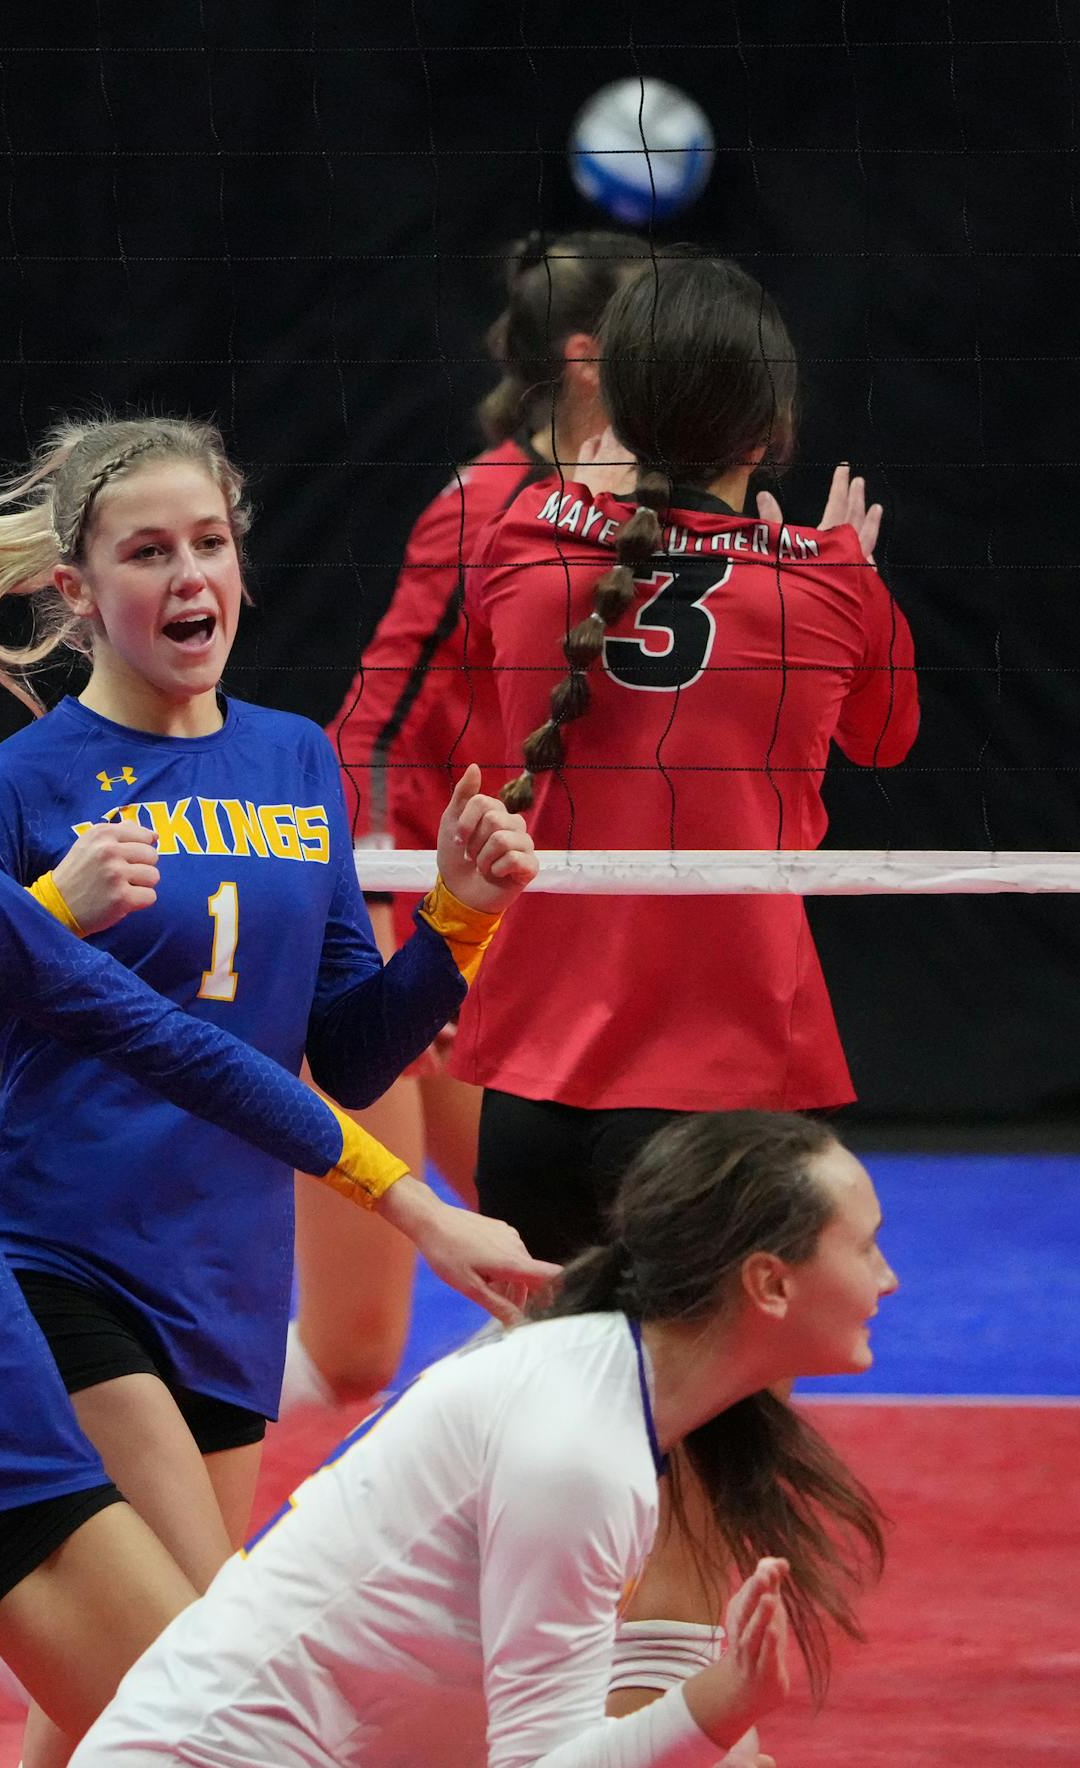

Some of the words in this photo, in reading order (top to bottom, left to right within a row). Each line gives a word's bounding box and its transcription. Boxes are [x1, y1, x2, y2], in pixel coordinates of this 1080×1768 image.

[536, 490, 621, 546] MAYE
[666, 522, 820, 561] UTHERAN
[603, 552, 733, 692] 3
[196, 881, 239, 1002] 1
